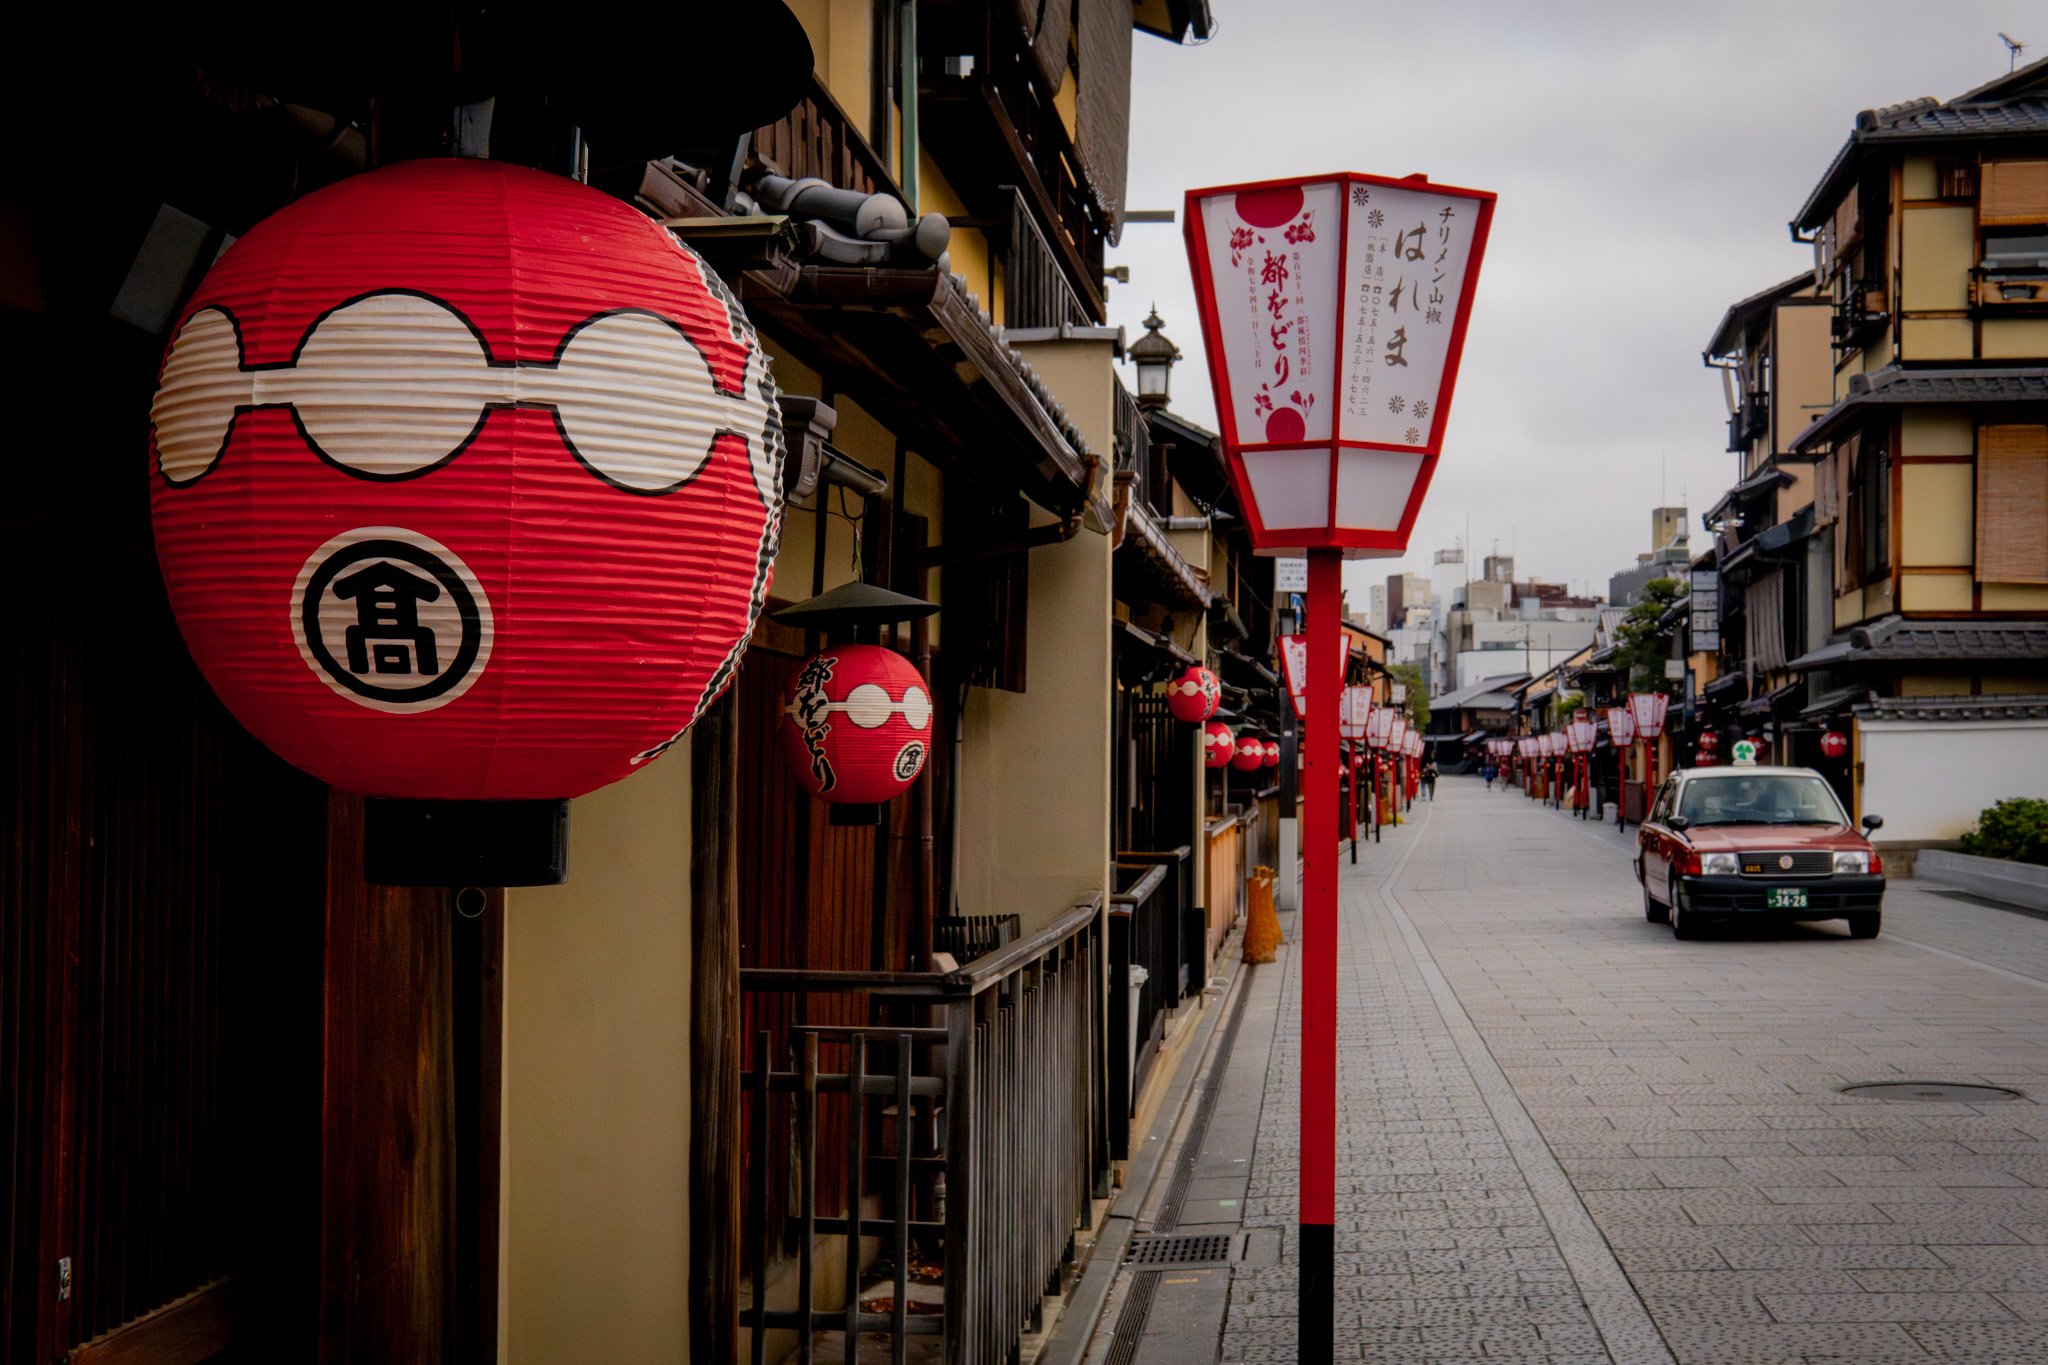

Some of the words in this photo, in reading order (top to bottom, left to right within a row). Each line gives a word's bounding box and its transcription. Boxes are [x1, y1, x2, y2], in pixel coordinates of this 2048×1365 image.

[1261, 250, 1294, 389] 都をどり
[1384, 221, 1427, 368] はれま
[1425, 206, 1455, 325] チリメン山椒
